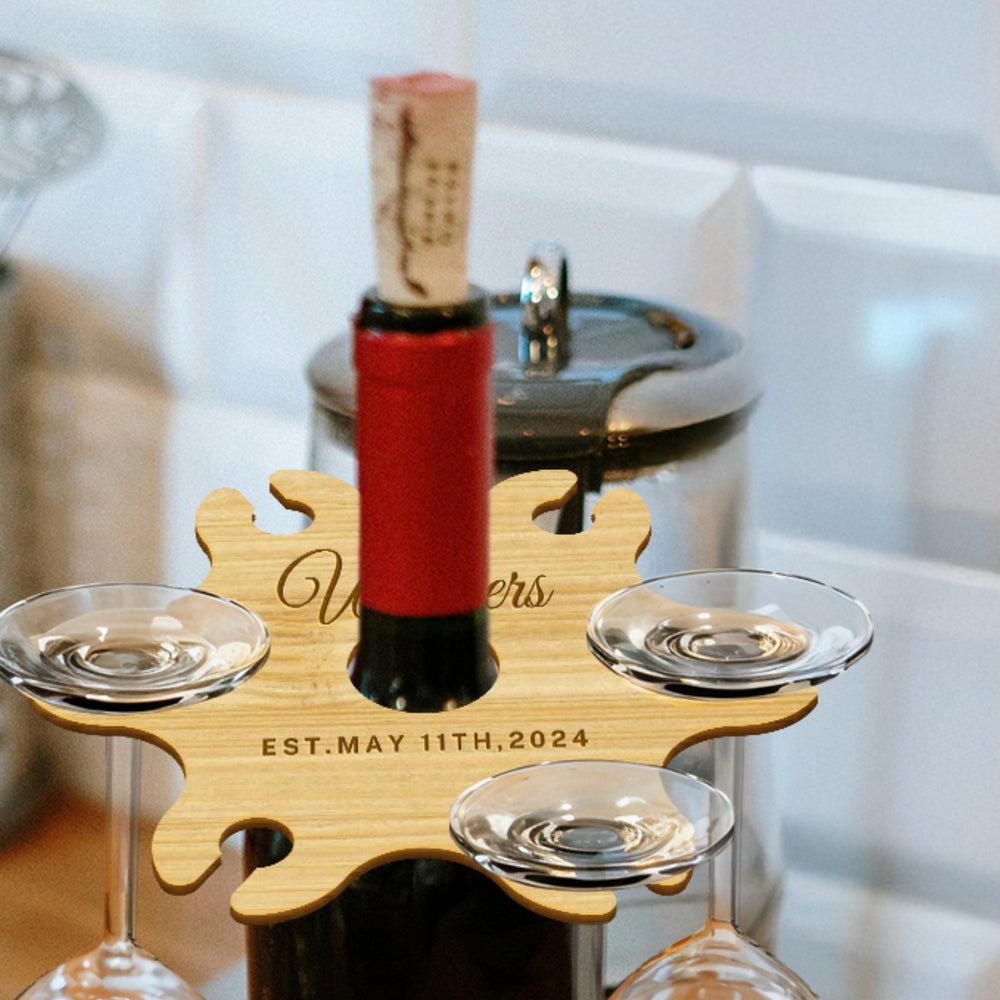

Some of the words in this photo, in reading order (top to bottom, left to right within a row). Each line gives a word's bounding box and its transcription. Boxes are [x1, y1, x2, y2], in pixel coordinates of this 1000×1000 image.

[277, 548, 554, 625] Wers
[261, 733, 405, 756] EST.MAY
[420, 728, 589, 752] 11TH,2024
